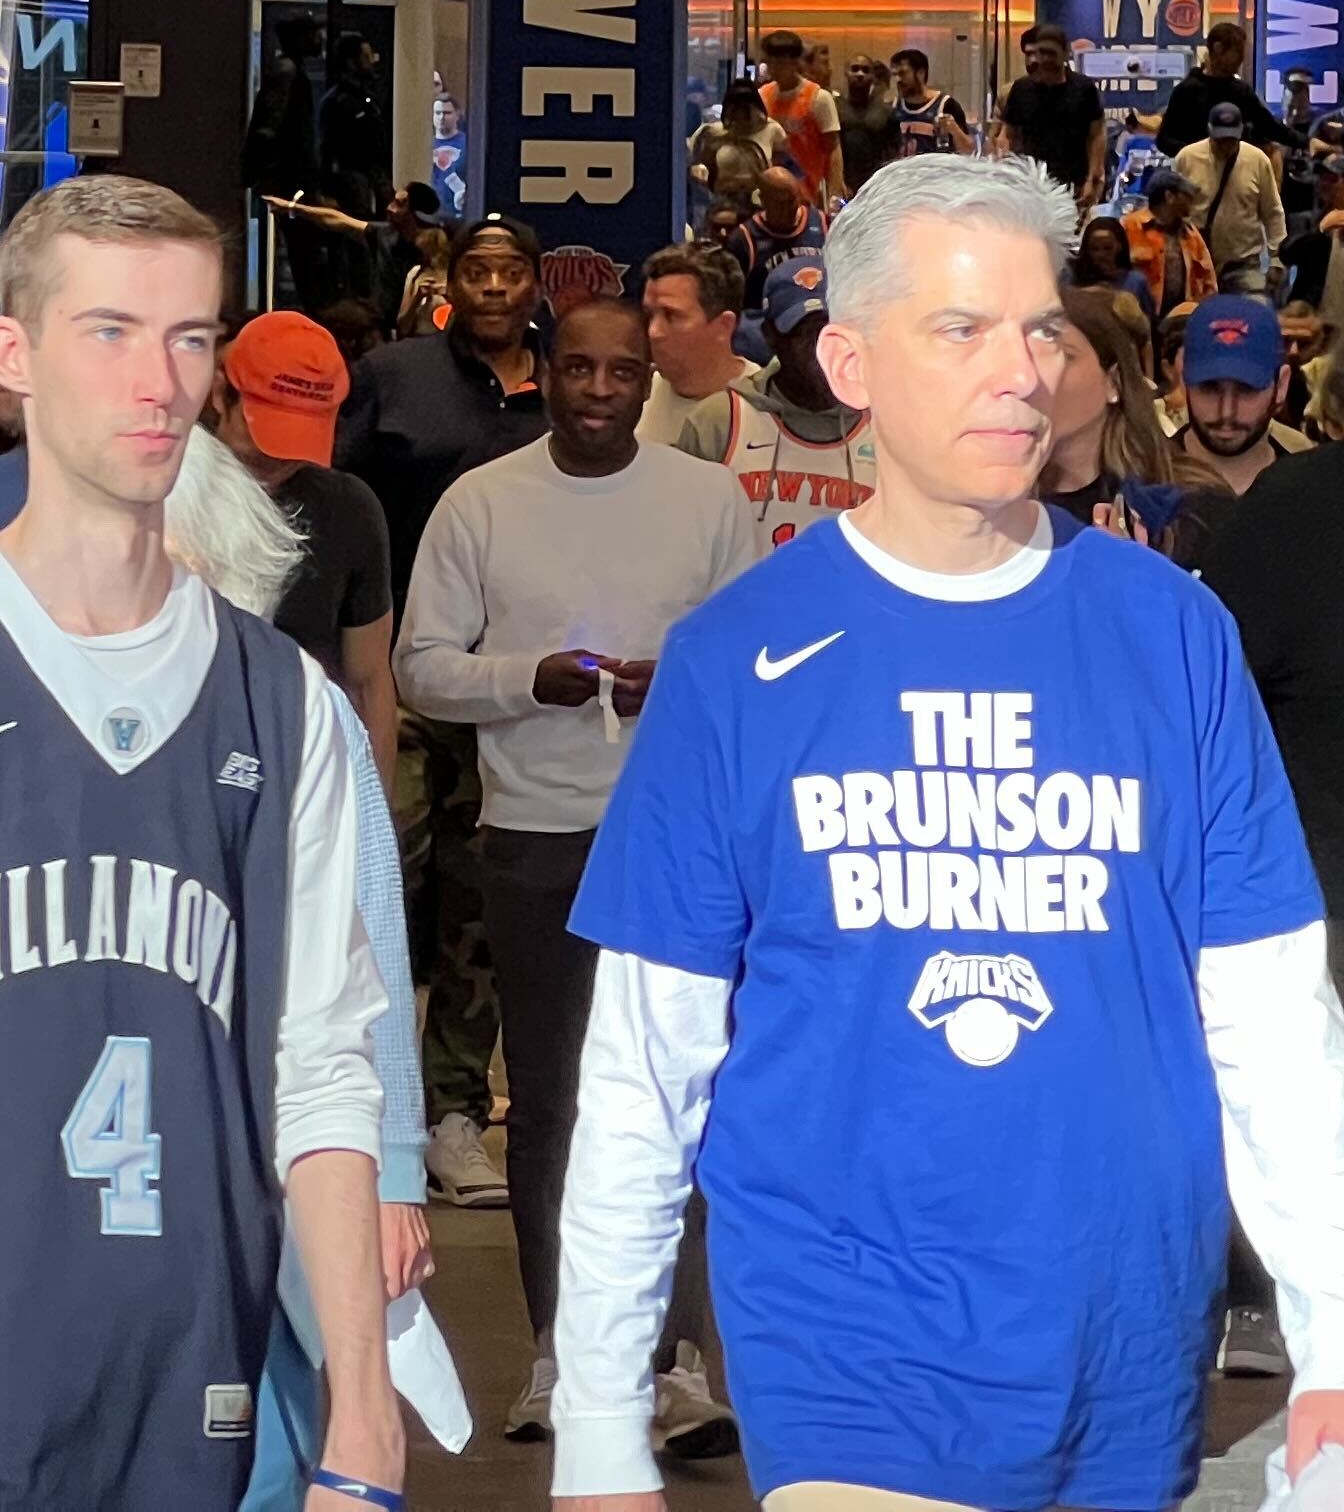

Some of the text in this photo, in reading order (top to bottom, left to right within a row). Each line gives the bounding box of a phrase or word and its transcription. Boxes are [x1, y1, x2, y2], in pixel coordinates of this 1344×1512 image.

[228, 751, 261, 772] BIG
[901, 691, 1033, 769] THE
[792, 771, 1140, 853] BRUNSON
[828, 851, 1110, 933] BURNER
[916, 958, 1046, 1013] KNICKS
[61, 1035, 163, 1237] 4
